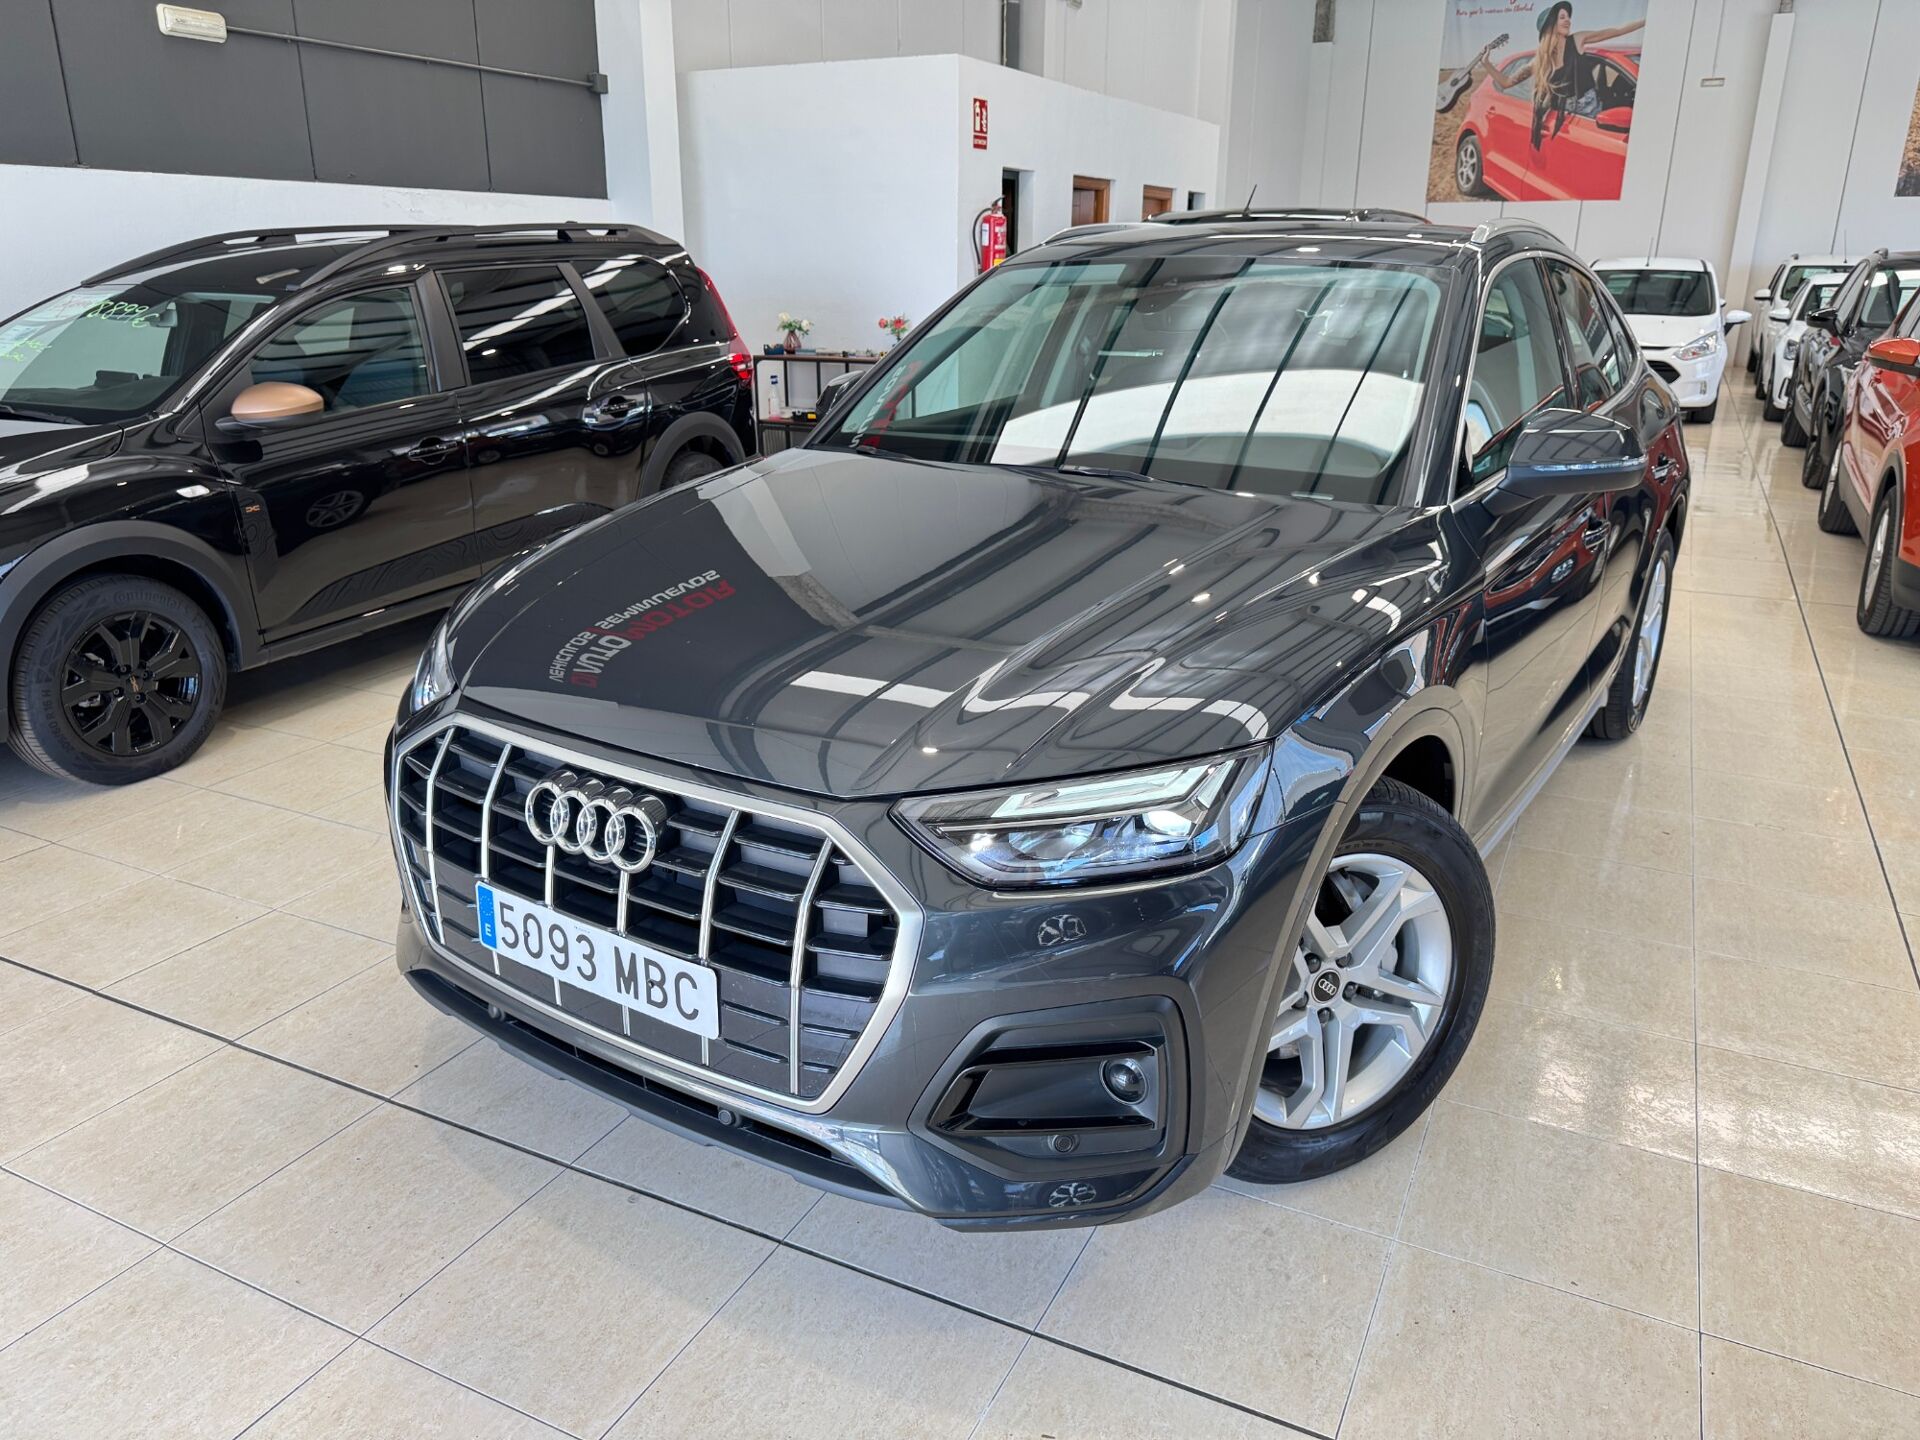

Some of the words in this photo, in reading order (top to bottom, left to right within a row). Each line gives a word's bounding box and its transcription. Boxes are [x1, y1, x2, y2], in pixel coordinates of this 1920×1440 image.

[485, 923, 492, 937] E
[499, 901, 598, 982] 5093
[613, 945, 699, 1022] MBC
